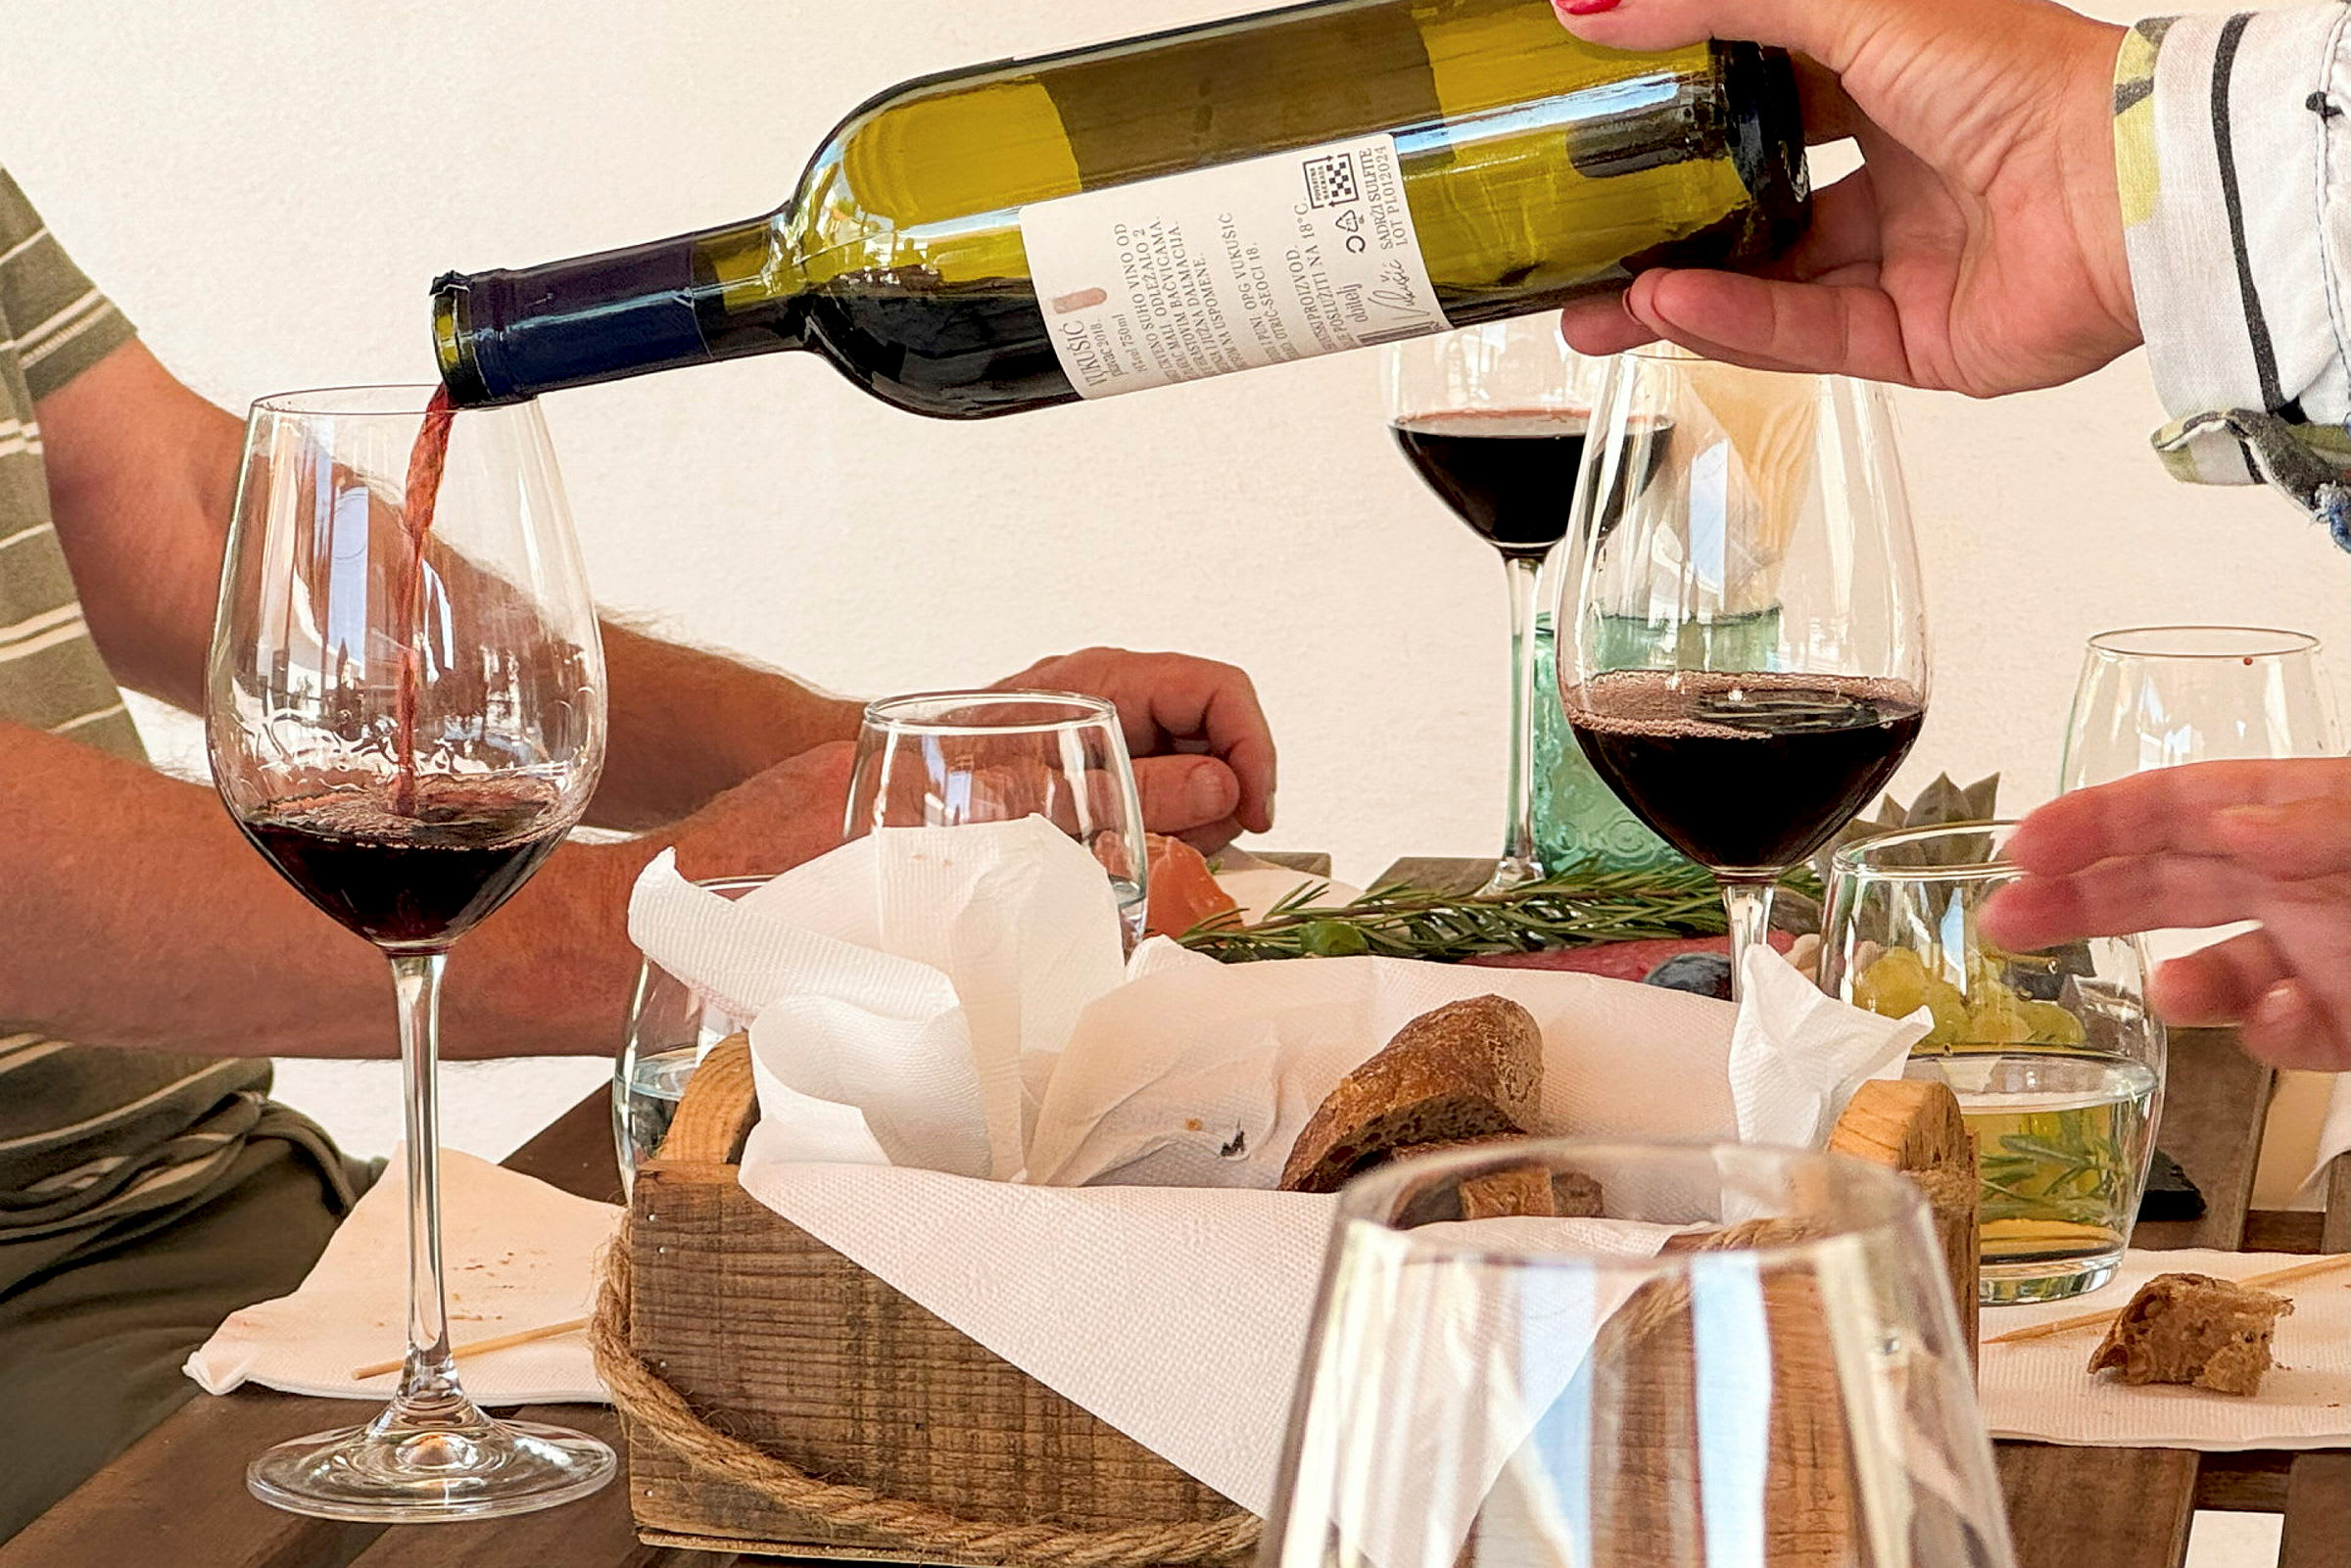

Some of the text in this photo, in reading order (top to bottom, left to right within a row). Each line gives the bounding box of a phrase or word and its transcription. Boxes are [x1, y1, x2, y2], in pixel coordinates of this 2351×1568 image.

[1356, 146, 1394, 250] SADRŽI SULFITE
[1372, 145, 1409, 246] LOT PL012024
[1112, 221, 1130, 247] OD
[1132, 227, 1145, 237] 2
[1217, 212, 1247, 279] VUKUŠIĆ
[1243, 242, 1261, 261] 18.
[1119, 251, 1140, 289] VINO
[1148, 215, 1182, 308] BAČVICAMA.
[1166, 220, 1200, 307] DALMACIJA.
[1303, 244, 1322, 266] NA
[1134, 241, 1168, 317] ODLEŽALO
[1236, 281, 1259, 310] OPG
[1282, 244, 1321, 321] PROIZVOD.
[1130, 292, 1156, 330] SUHO
[1311, 270, 1347, 333] POSLUŽITI
[1336, 282, 1368, 323] obitelj
[1111, 312, 1134, 347] 750ml
[1190, 309, 1215, 344] JUŽNA
[1058, 319, 1107, 387] VUKUŠIĆ
